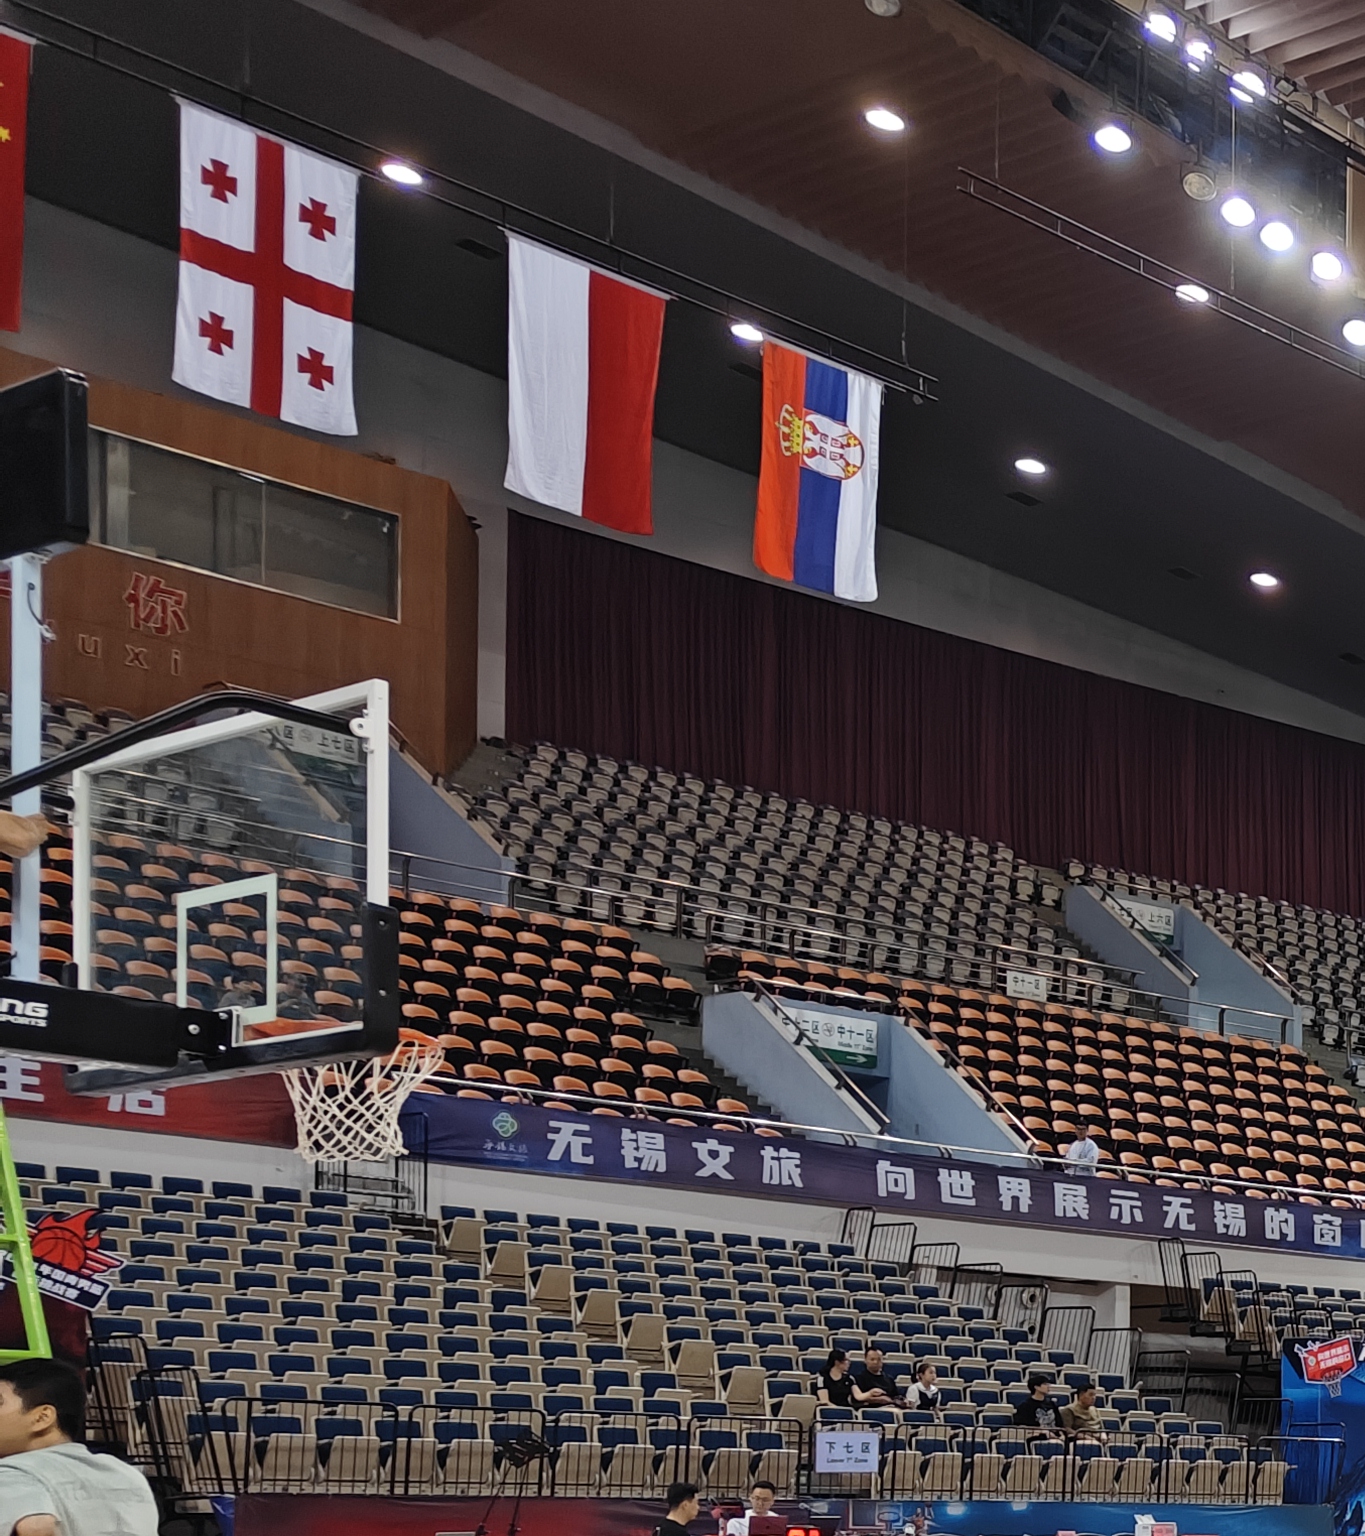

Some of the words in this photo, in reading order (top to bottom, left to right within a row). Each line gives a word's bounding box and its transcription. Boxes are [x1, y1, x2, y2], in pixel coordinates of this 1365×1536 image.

[122, 571, 189, 636] 你
[837, 1023, 875, 1044] 中十一区
[546, 1119, 804, 1188] 无锡文旅
[825, 1441, 871, 1454] 下七区
